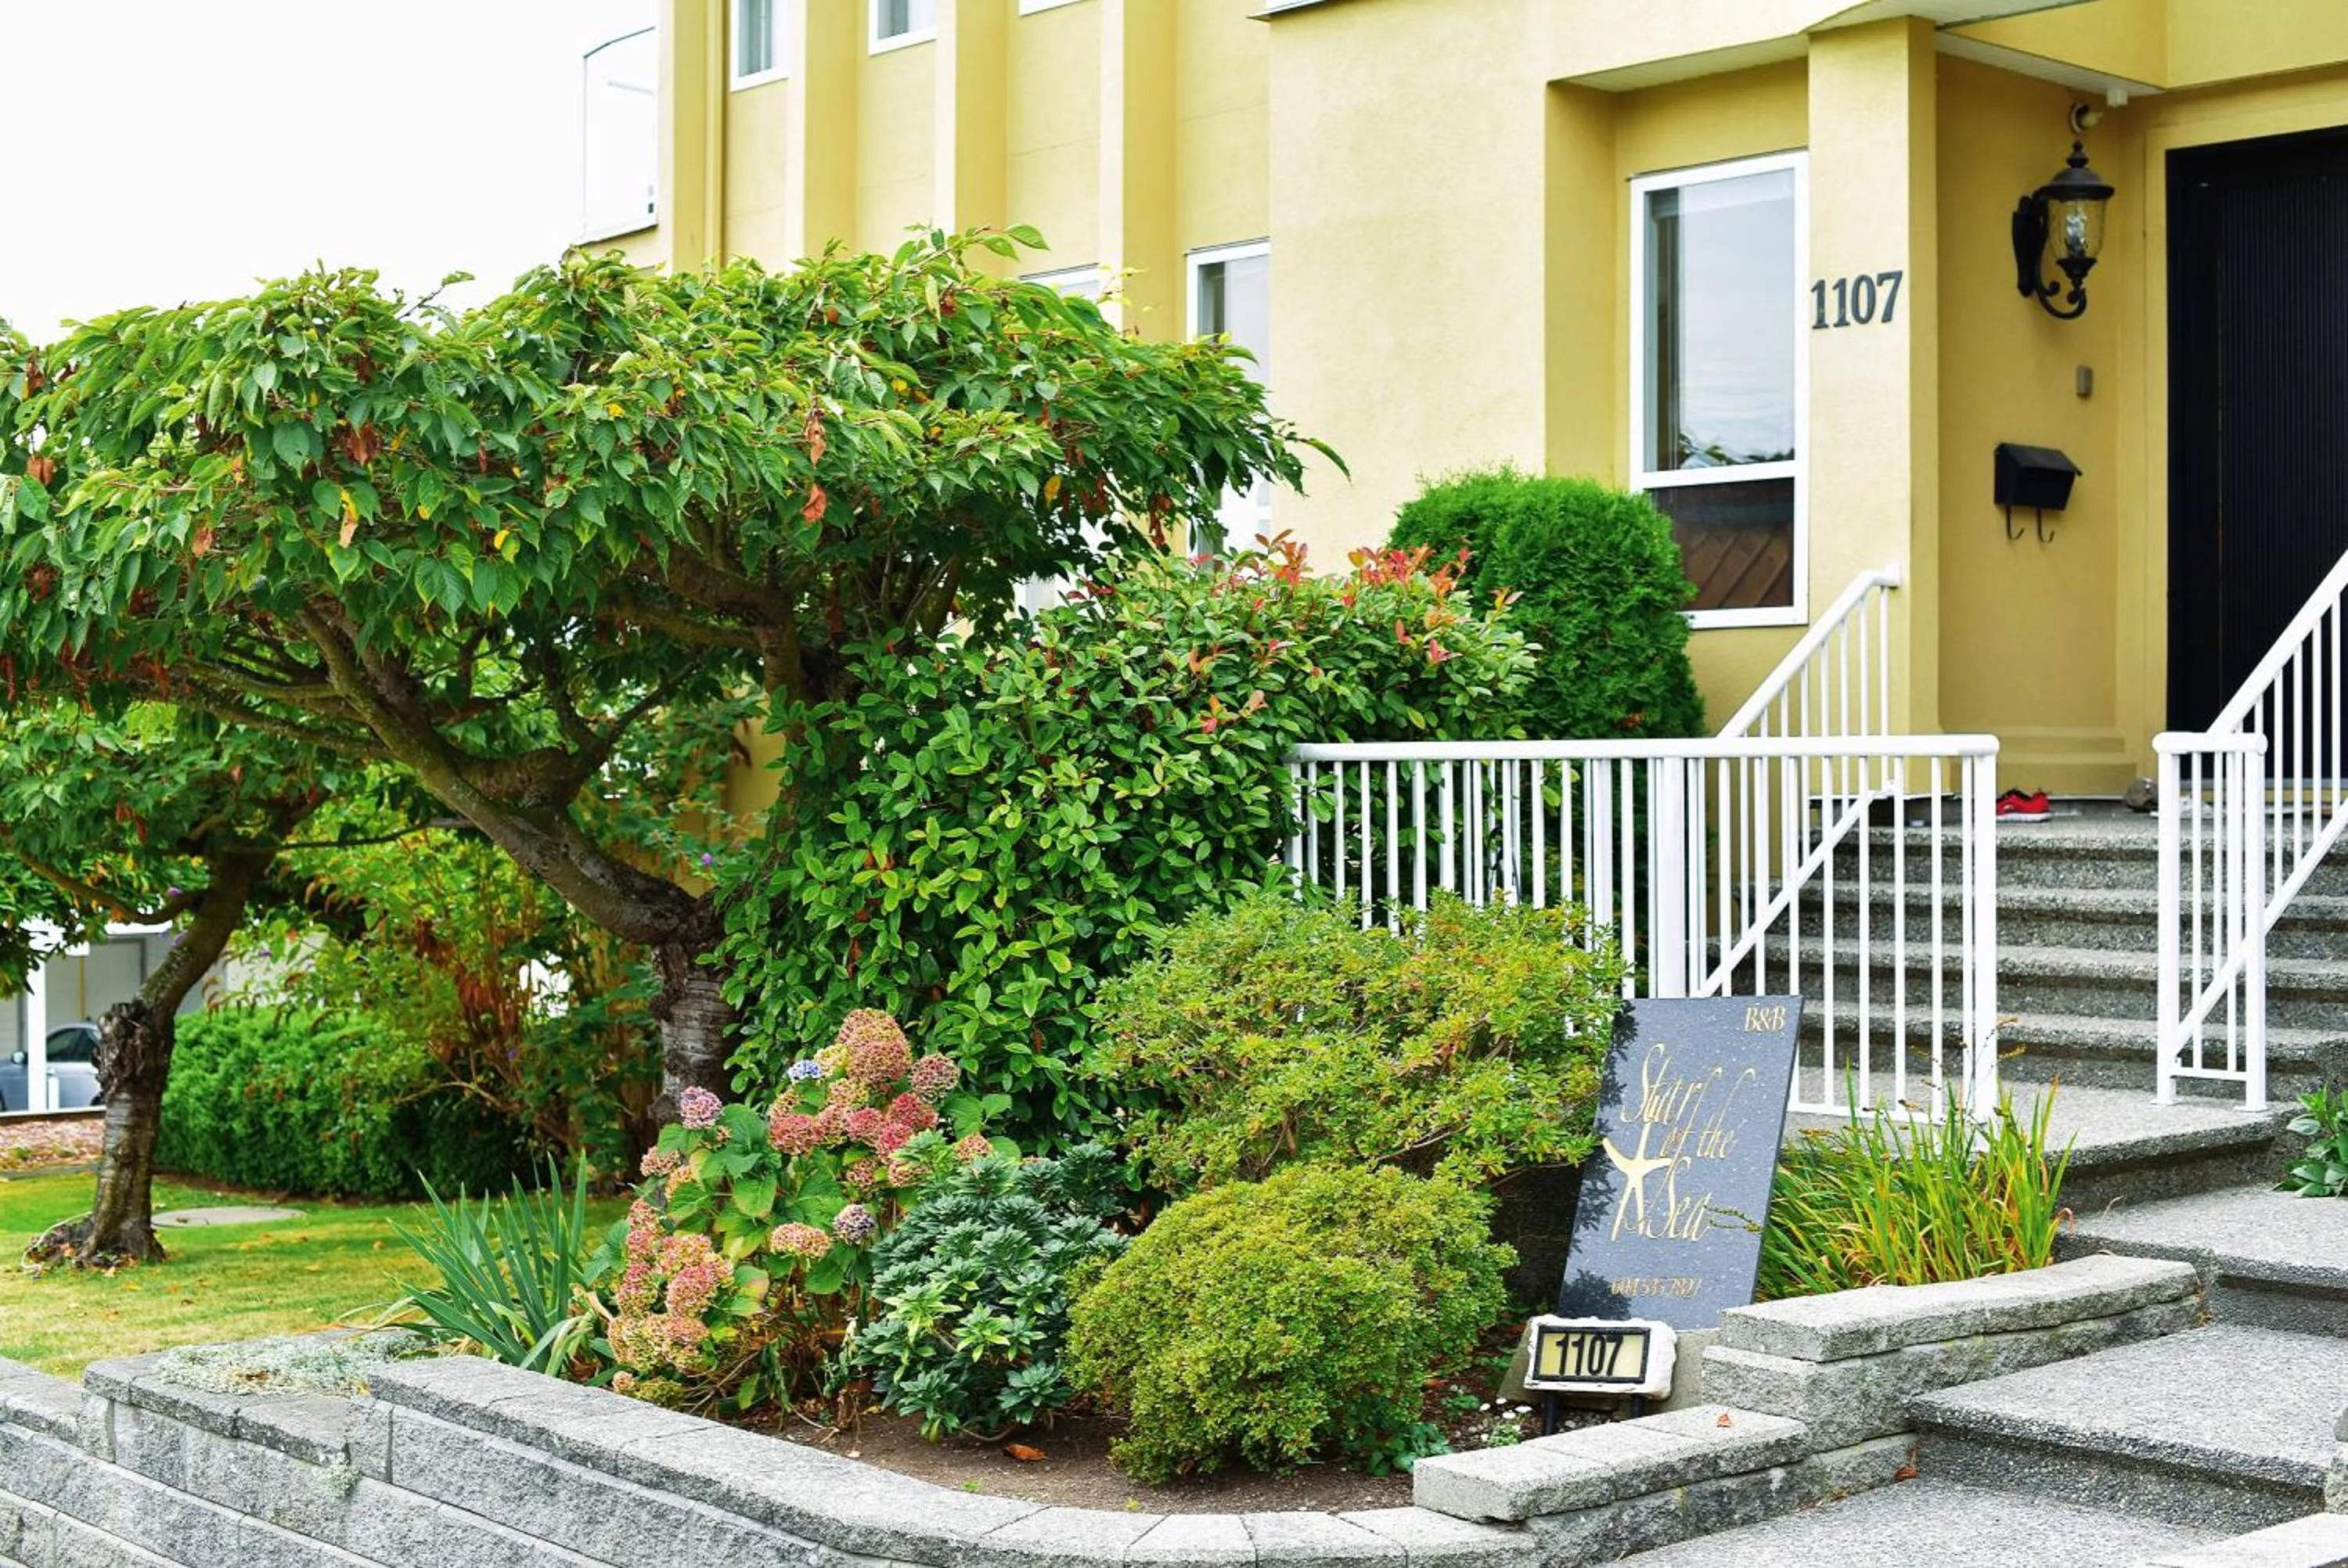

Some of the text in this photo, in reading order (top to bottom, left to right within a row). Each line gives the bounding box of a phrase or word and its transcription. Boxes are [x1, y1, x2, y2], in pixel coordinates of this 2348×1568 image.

[1810, 270, 1903, 329] 1107
[1744, 1006, 1786, 1032] B&B
[1620, 1043, 1704, 1124] Star
[1695, 1067, 1756, 1159] the
[1646, 1156, 1714, 1242] Sea
[1555, 1332, 1624, 1376] 1107
